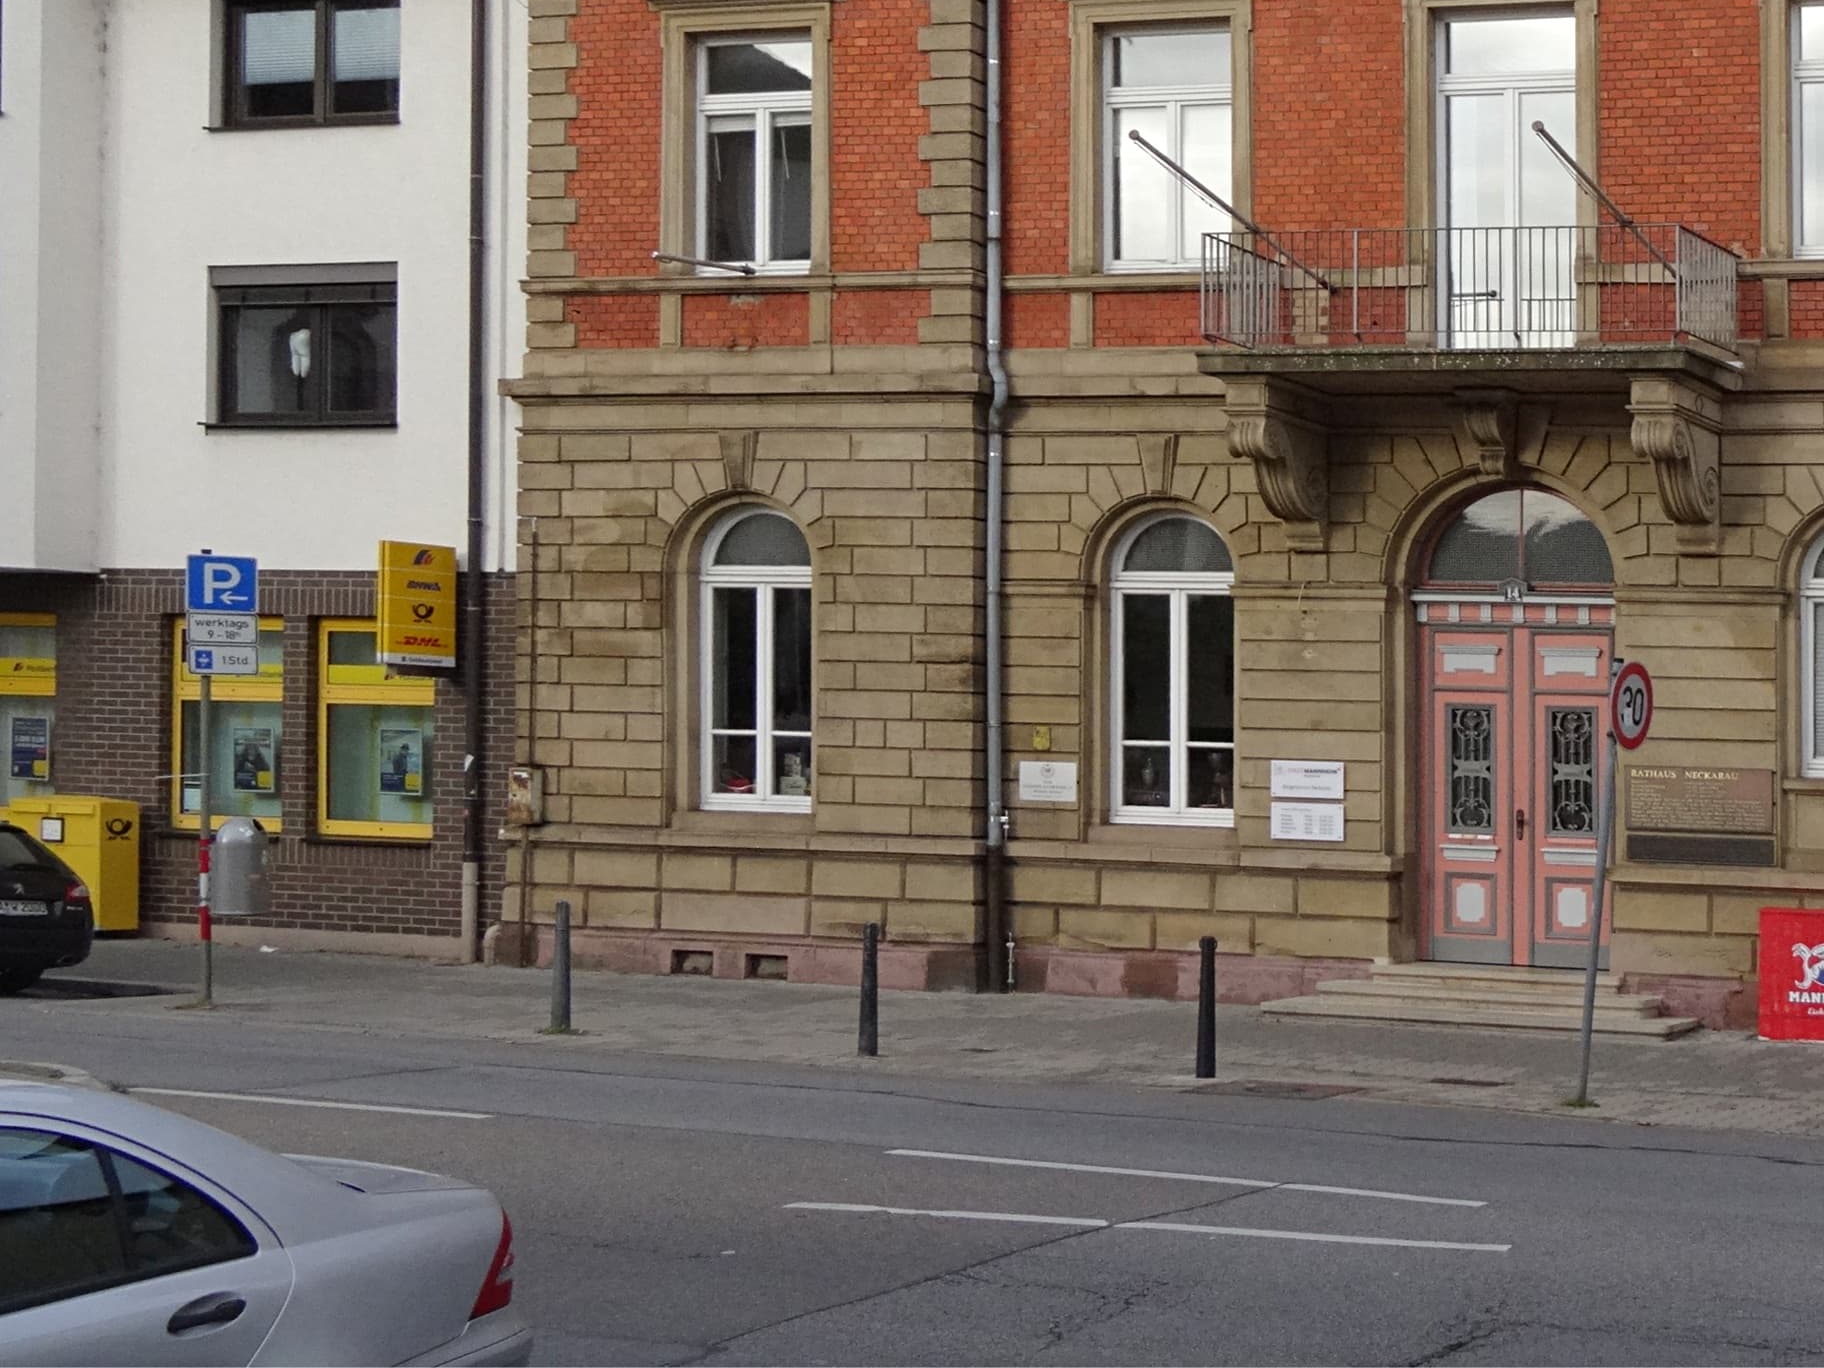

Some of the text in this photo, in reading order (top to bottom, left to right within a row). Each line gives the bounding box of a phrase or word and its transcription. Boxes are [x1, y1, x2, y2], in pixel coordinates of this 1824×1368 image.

[203, 562, 241, 604] P
[194, 618, 249, 630] werktags
[402, 635, 443, 648] DHL
[1621, 686, 1644, 726] 30
[1631, 769, 1739, 781] RATHAUS NECKARAU
